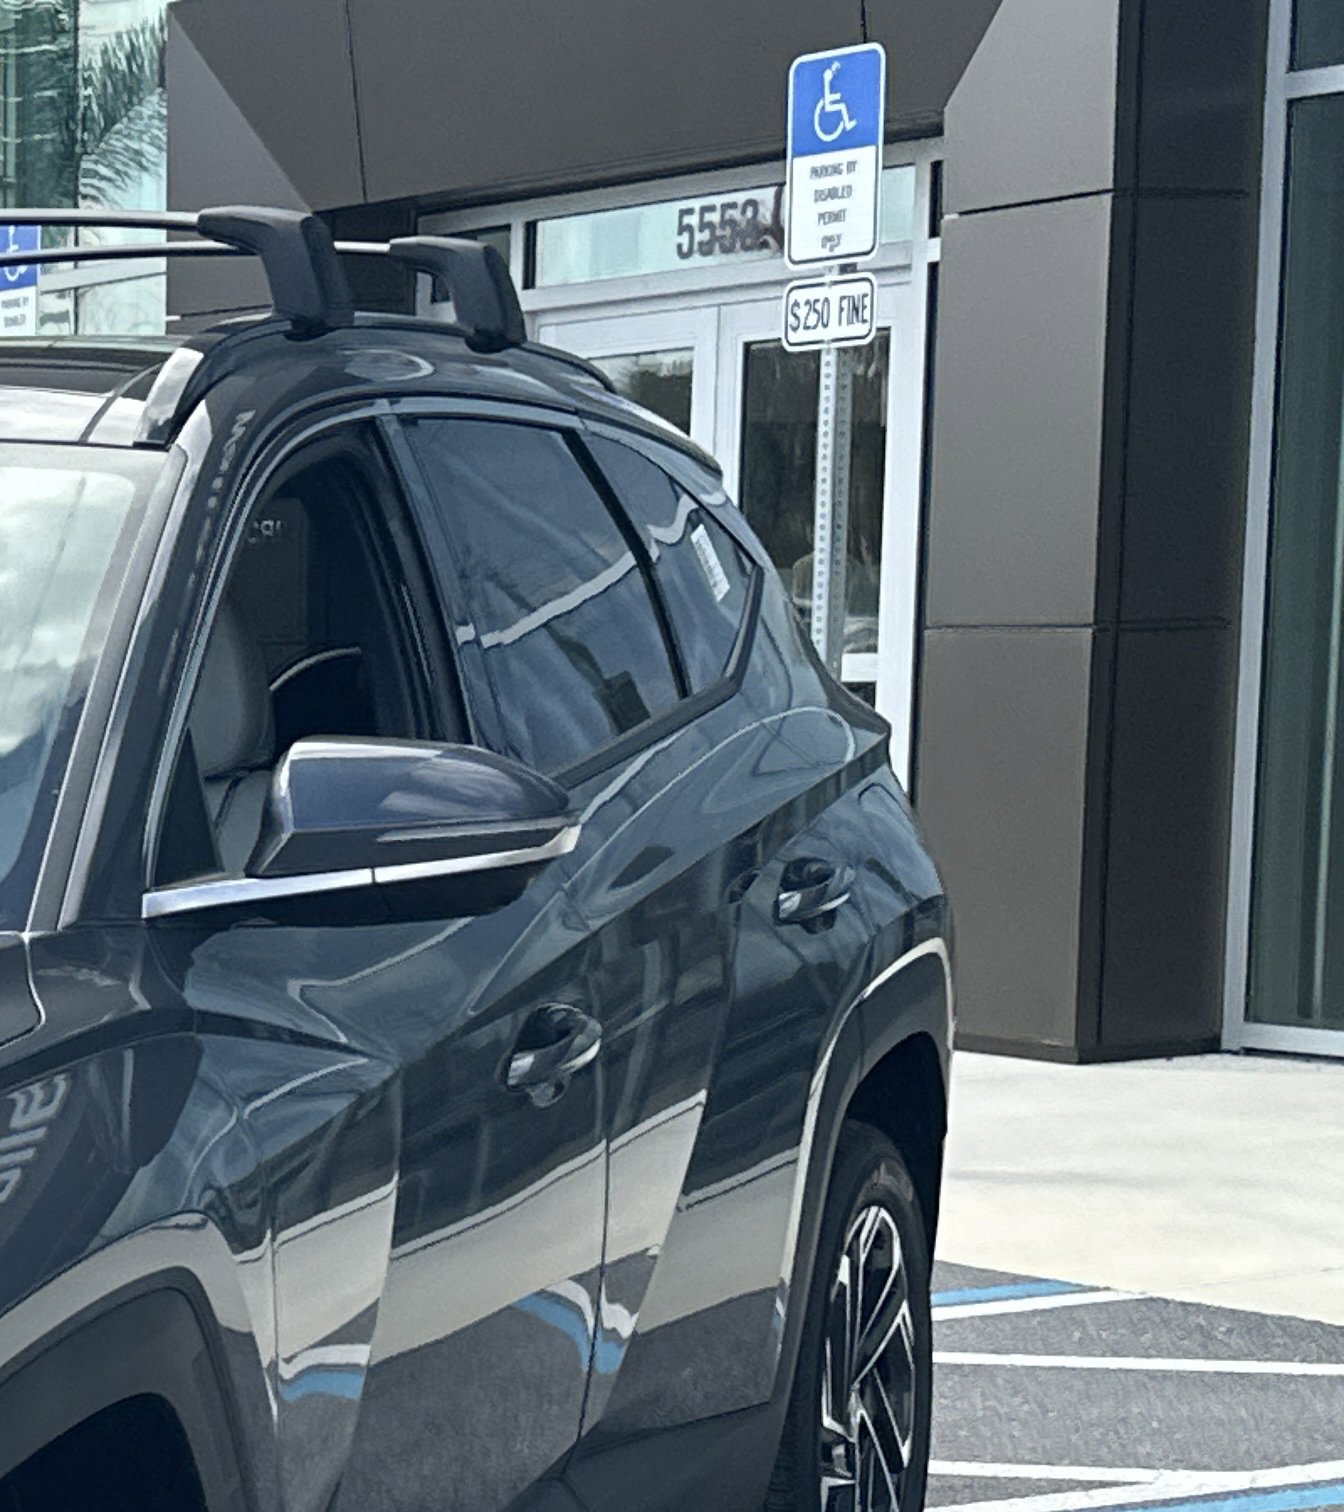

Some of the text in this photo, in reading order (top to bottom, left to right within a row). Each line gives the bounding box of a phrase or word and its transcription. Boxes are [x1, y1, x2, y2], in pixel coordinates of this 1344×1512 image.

[814, 184, 853, 203] DISABLED
[817, 208, 847, 226] PERMIT
[789, 293, 869, 333] $250 FINE
